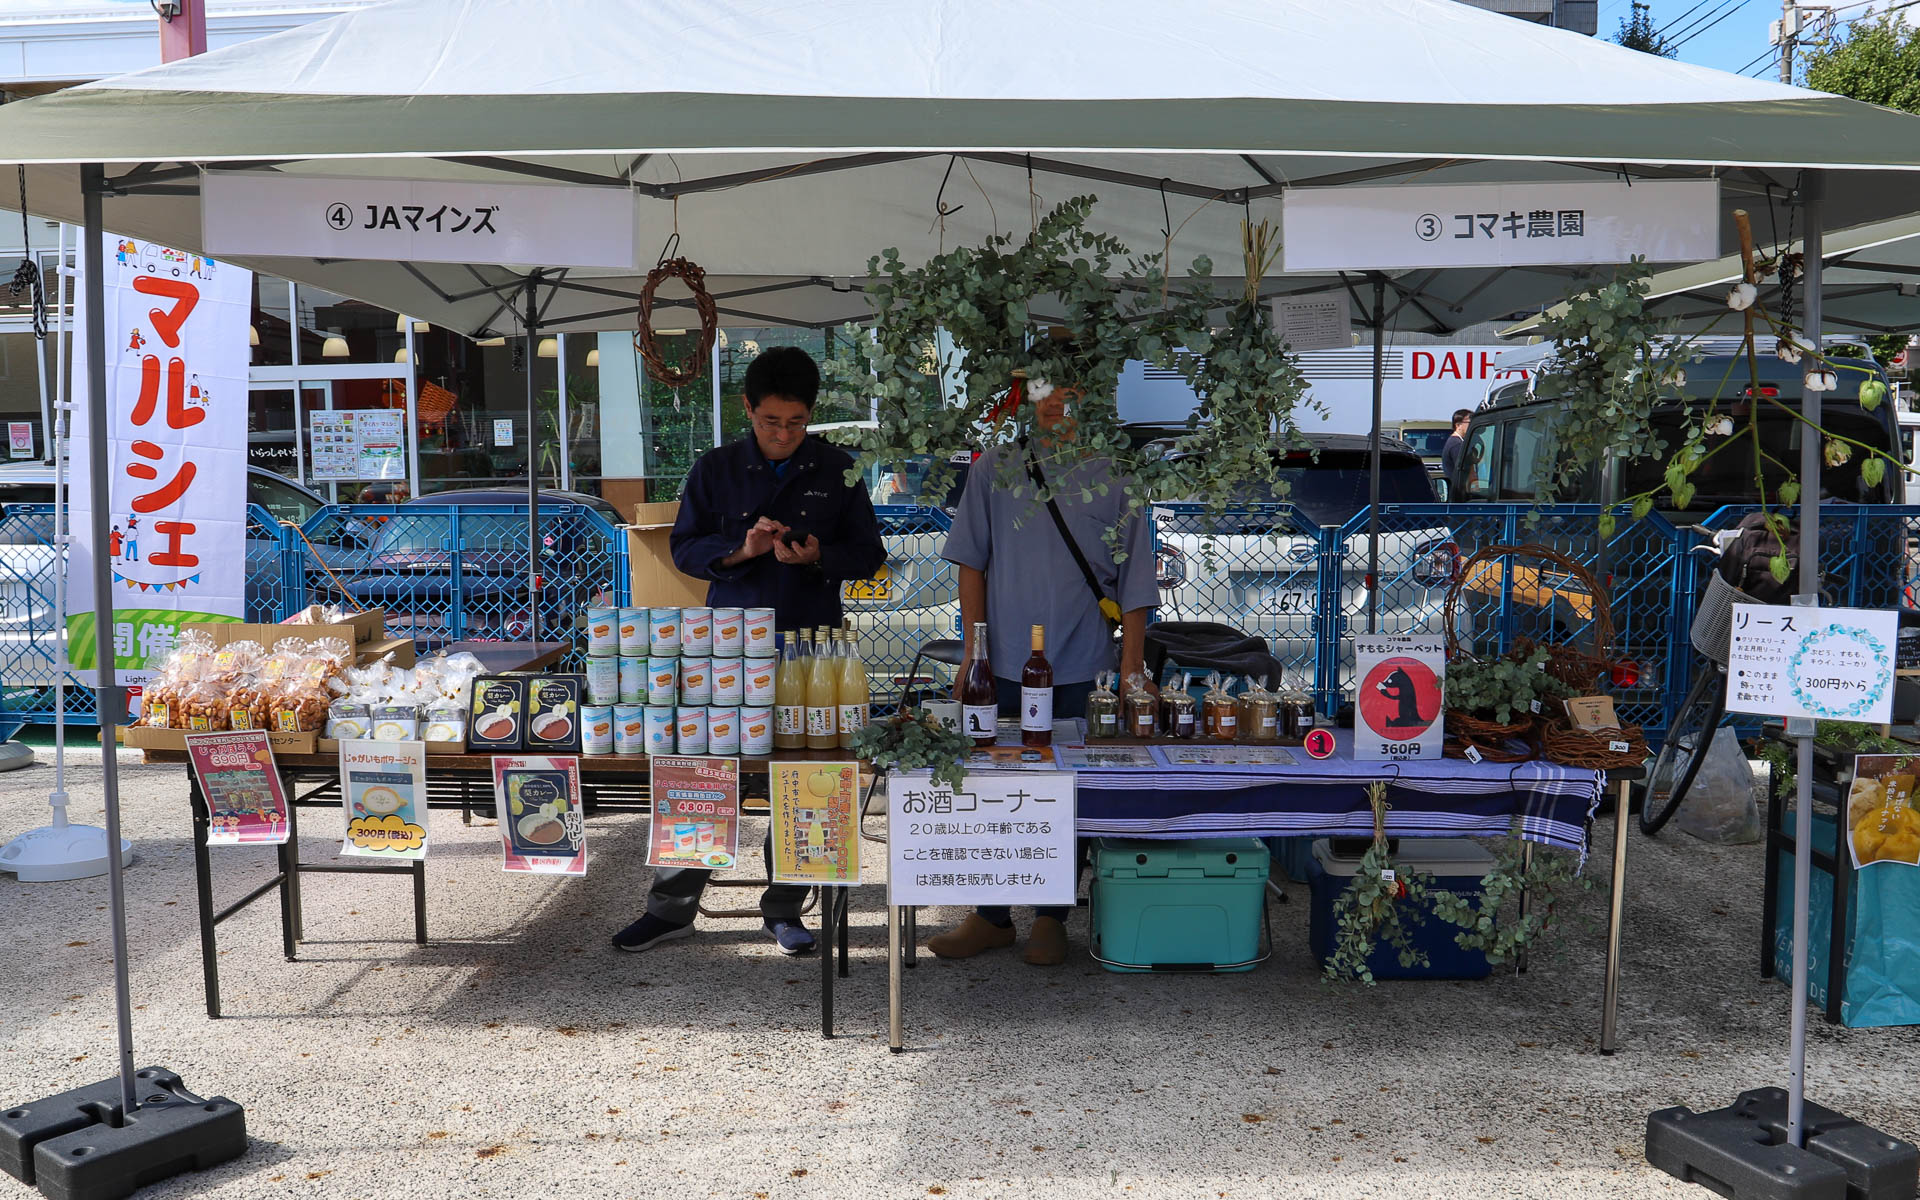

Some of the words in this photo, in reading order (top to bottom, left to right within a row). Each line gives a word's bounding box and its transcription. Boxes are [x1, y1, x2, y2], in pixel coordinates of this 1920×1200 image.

[364, 204, 500, 235] JAマインズ
[1454, 210, 1585, 240] コマキ農園
[126, 275, 206, 567] マルシェ
[1736, 612, 1797, 632] リース
[1357, 644, 1442, 653] すももシャーベット
[125, 675, 148, 684] Light
[1805, 677, 1867, 692] 300円から
[1381, 743, 1421, 755] 360円
[212, 753, 250, 766] 390円
[678, 803, 714, 813] 480円
[903, 789, 1057, 814] お酒コーナー
[910, 821, 1052, 835] 20歳以上の年齢である
[903, 847, 1058, 861] ことを確認できない場合に
[916, 873, 1046, 887] は酒類を販売しません
